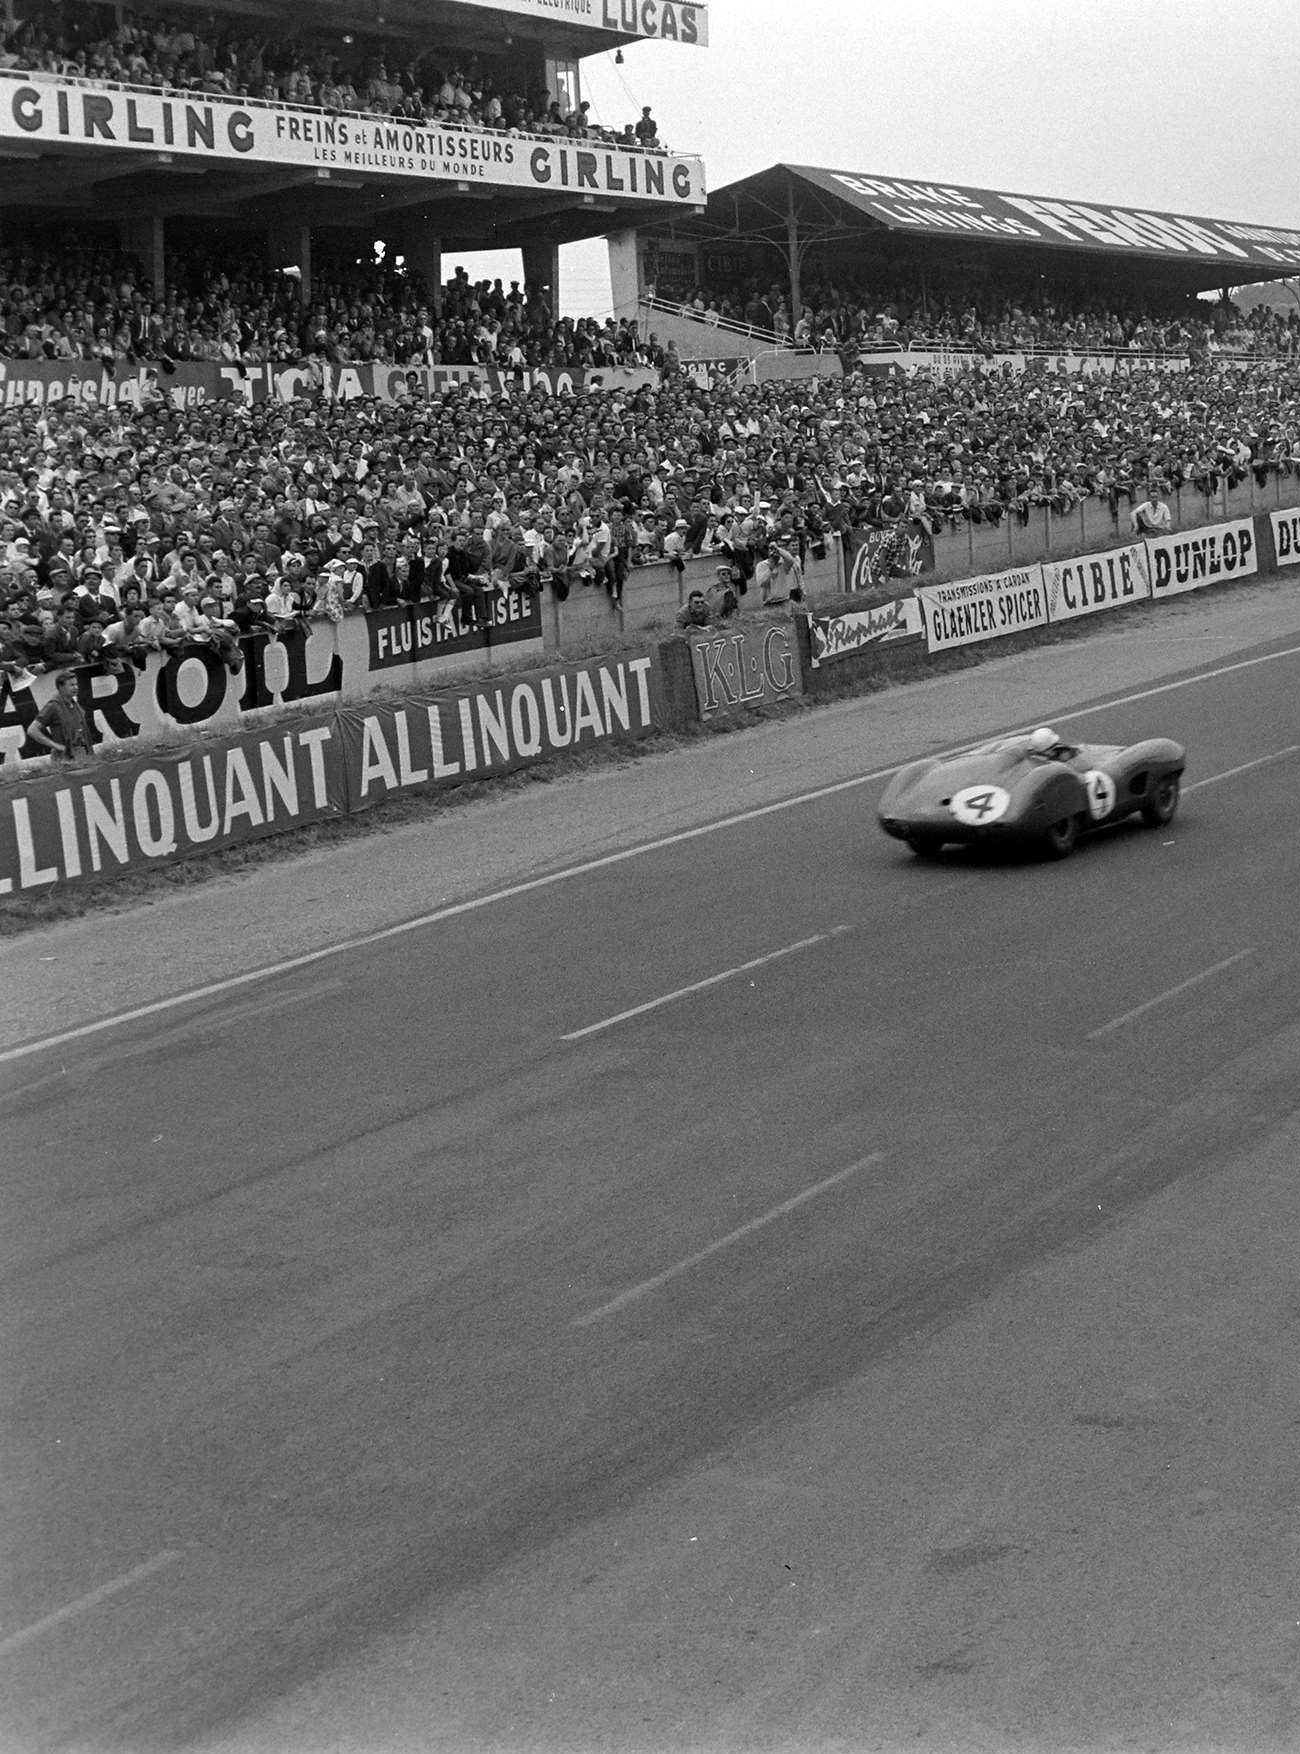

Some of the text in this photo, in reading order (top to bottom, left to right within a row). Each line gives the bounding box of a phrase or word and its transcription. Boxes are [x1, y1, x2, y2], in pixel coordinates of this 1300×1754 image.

[602, 0, 698, 44] LUCAS
[12, 87, 254, 153] GIRLING
[276, 116, 514, 164] FREINS et AMORTISSEURS
[314, 148, 485, 177] LES MEILLEURS DU MONDE
[530, 147, 691, 198] GIRLING
[830, 174, 984, 209] BRAKE
[870, 202, 1041, 237] LININGS
[998, 195, 1249, 258] FERODO
[1155, 529, 1252, 587] DUNLOP
[937, 580, 994, 602] TRANSMISSIONS
[1004, 573, 1031, 590] CARDAN
[933, 600, 997, 641] GLAENZER
[998, 588, 1042, 626] SPICER
[361, 657, 650, 797] ALLINQUANT
[966, 792, 996, 819] 4
[1095, 777, 1108, 813] 4
